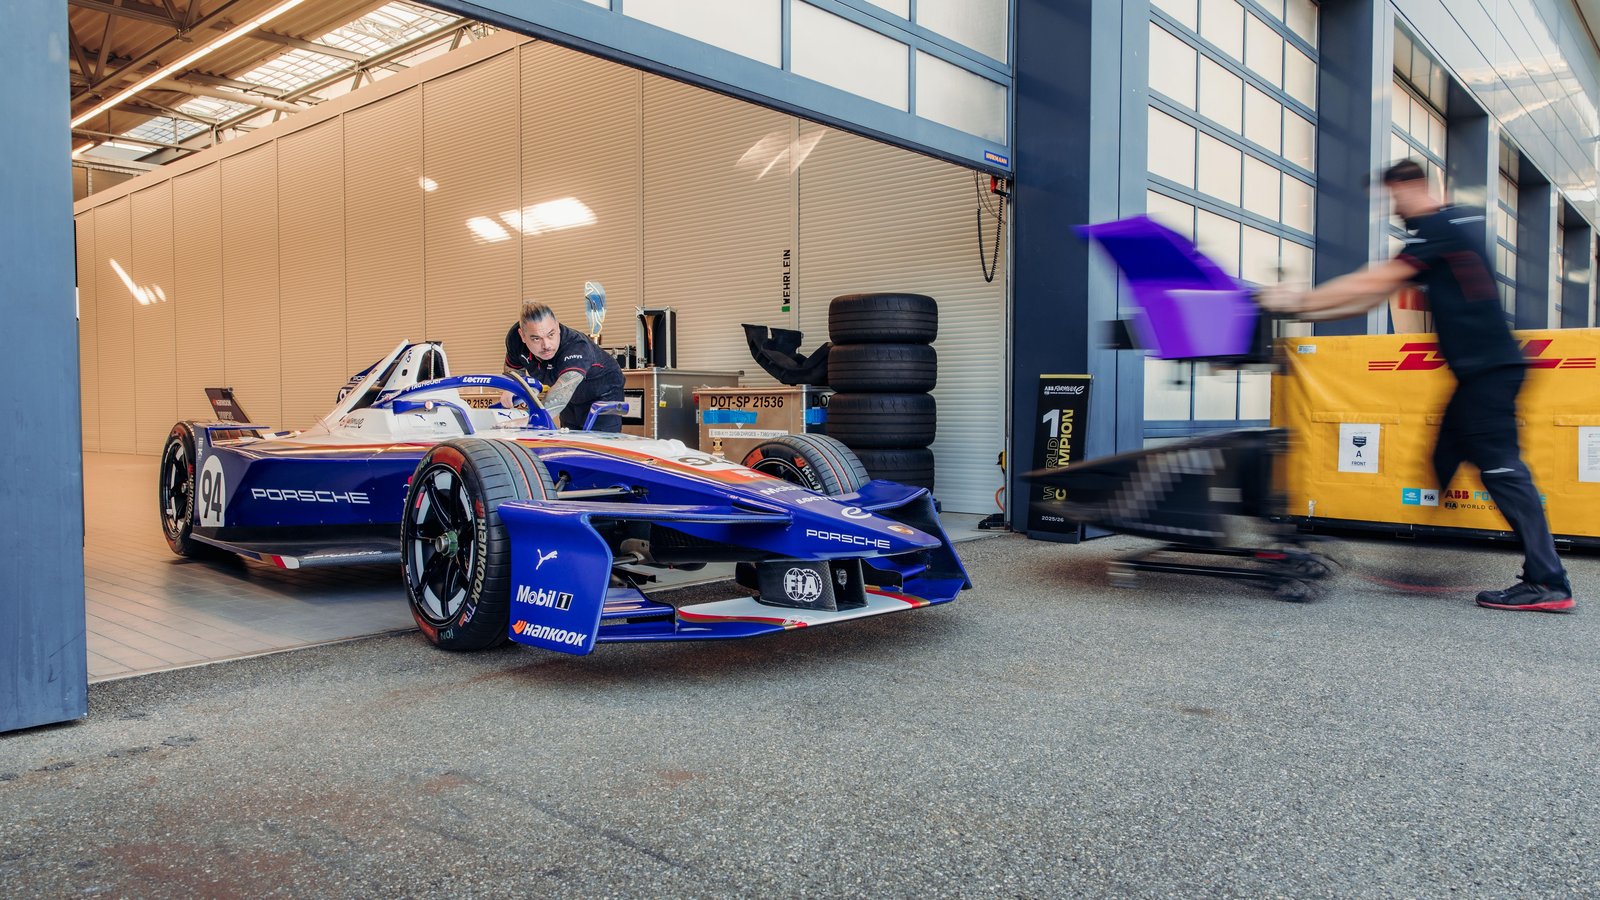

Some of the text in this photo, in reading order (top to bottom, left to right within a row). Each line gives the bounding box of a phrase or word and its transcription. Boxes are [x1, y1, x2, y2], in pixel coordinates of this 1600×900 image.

[1395, 339, 1563, 371] DL
[462, 376, 492, 384] LOCTITE
[710, 396, 784, 408] DOT-SP 21536
[1042, 408, 1060, 438] 1
[1055, 409, 1074, 501] CMPION
[1355, 450, 1362, 458] A
[1042, 437, 1060, 500] WRLD
[202, 469, 222, 522] 94
[251, 488, 371, 505] PORSCHE
[1444, 490, 1469, 500] ABB
[806, 529, 891, 549] PORSCHE
[516, 584, 557, 608] Mobil
